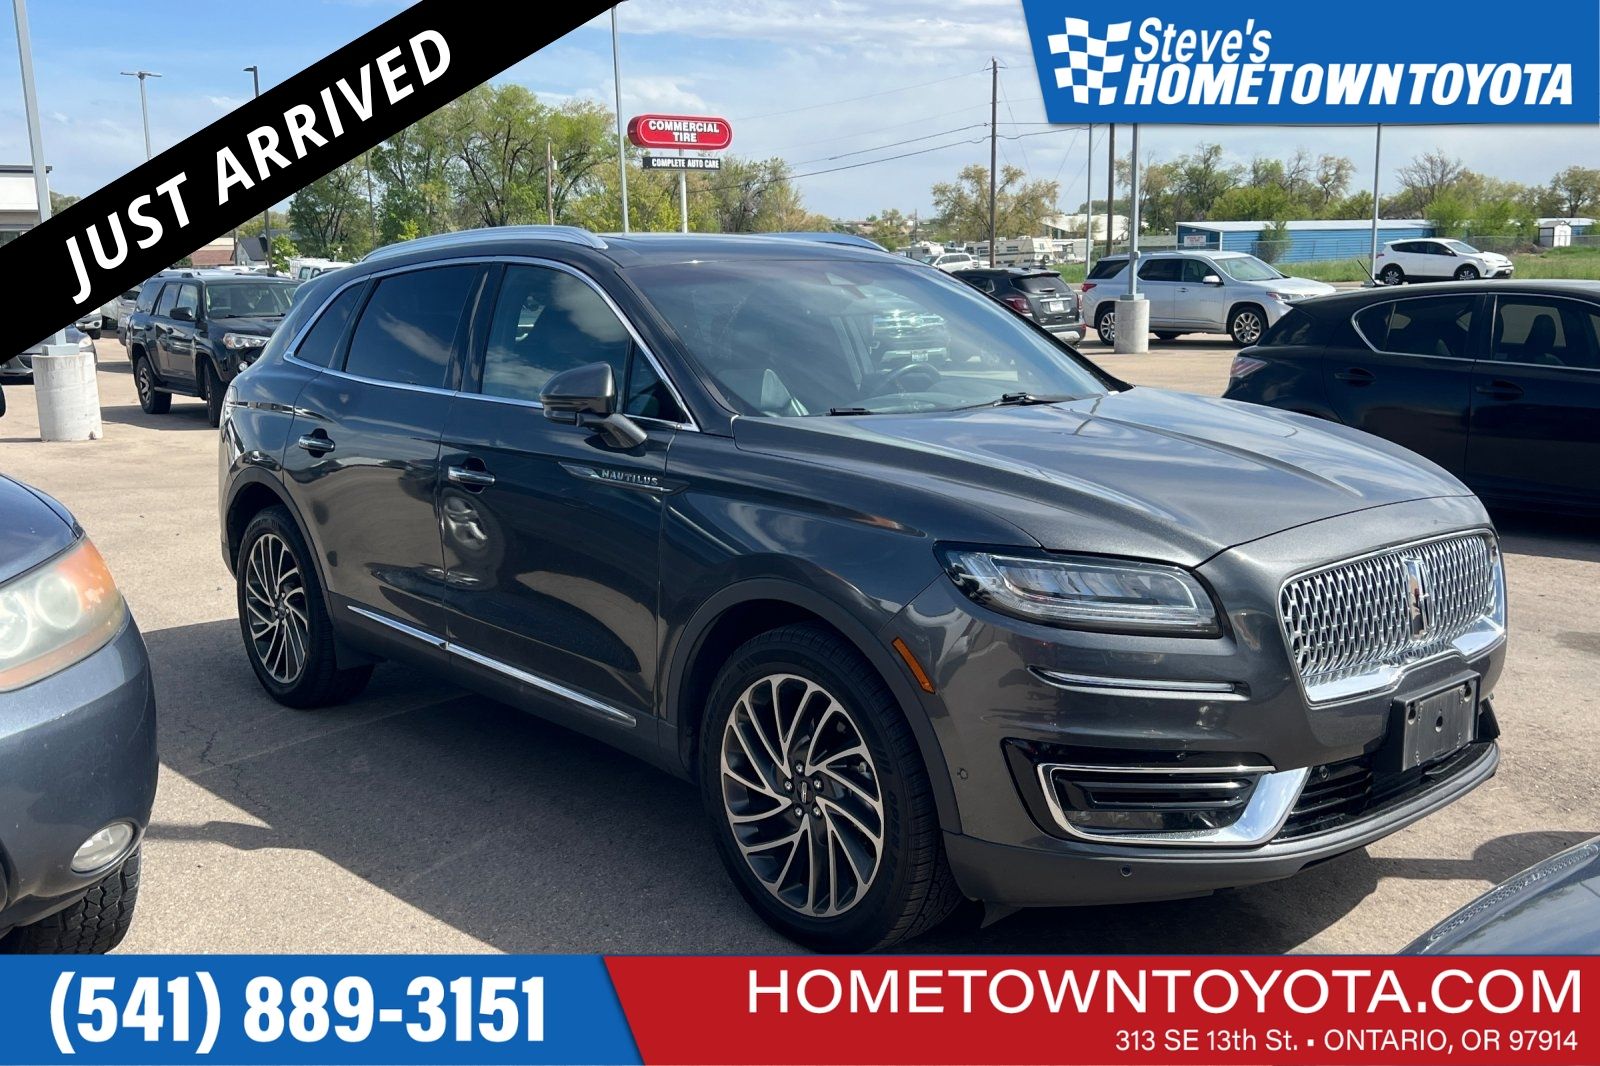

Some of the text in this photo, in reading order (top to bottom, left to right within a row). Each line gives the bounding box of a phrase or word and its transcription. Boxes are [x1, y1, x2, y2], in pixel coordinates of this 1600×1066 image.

[648, 120, 720, 133] COMMERCIAL
[672, 132, 697, 143] TIRE
[651, 158, 719, 169] COMPLETE AUTO CARE
[601, 469, 659, 486] NAUTILUS
